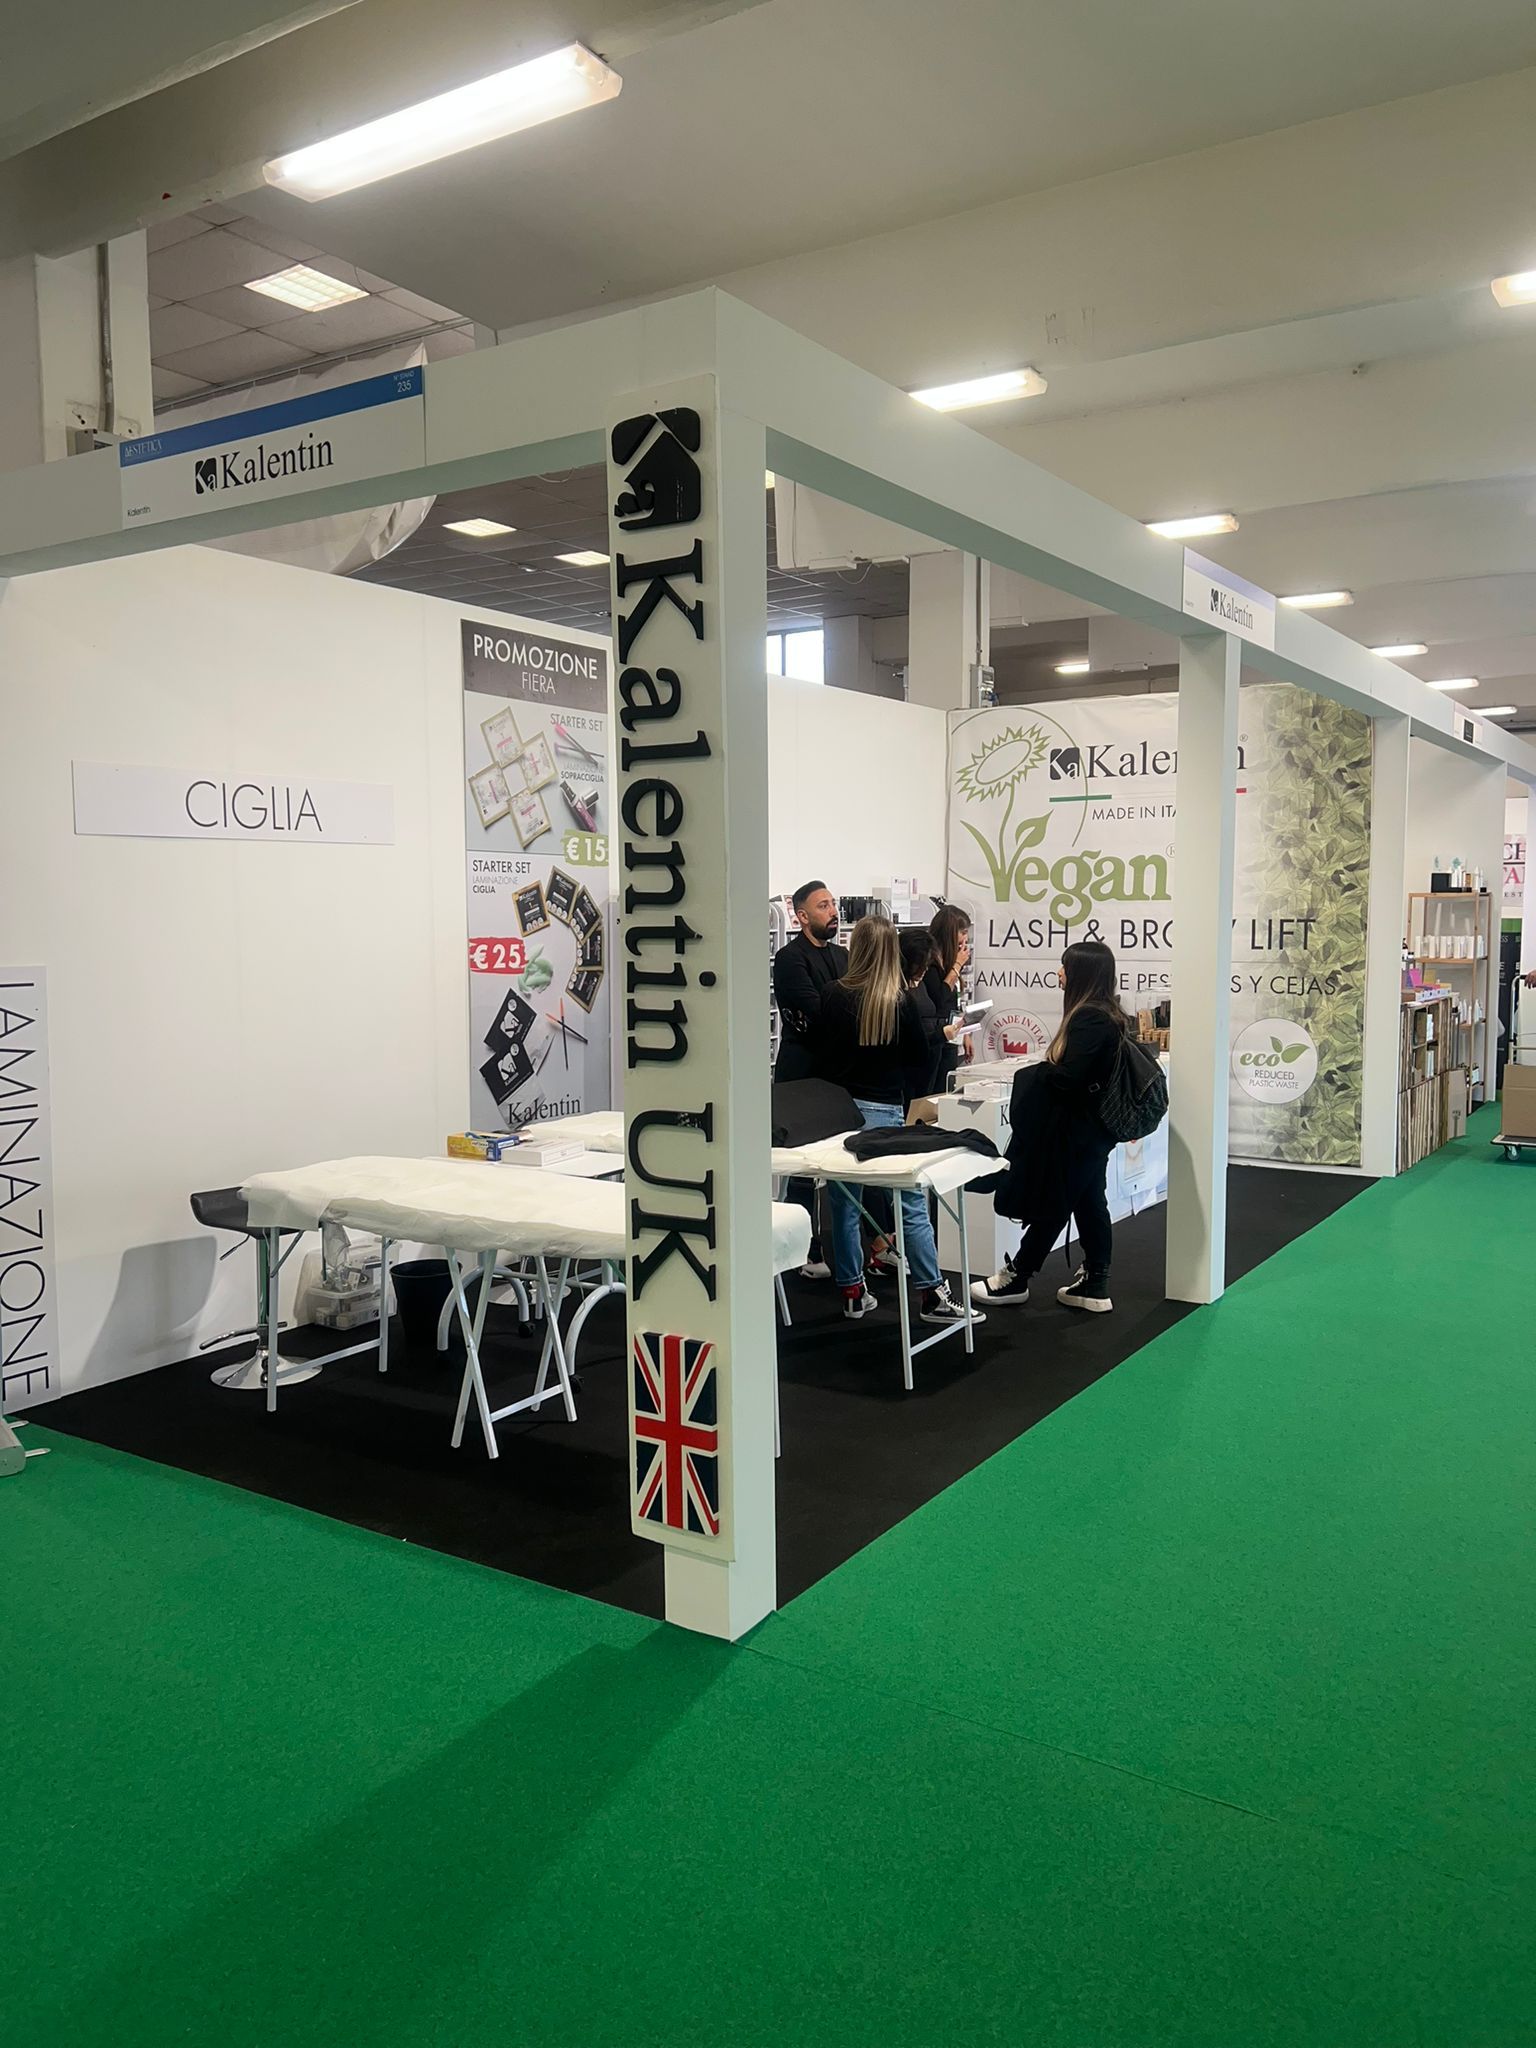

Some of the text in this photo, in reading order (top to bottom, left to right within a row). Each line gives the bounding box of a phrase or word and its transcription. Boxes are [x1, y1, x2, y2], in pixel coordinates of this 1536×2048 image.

[397, 380, 411, 392] 235
[220, 432, 334, 490] Kalentin
[1219, 592, 1253, 630] Kalentin
[473, 633, 598, 680] PROMOZIONE
[521, 671, 556, 694] FIERA
[550, 713, 604, 732] STARTER SET
[560, 770, 605, 783] SOPRACCIGLIA
[185, 781, 323, 832] CIGLIA
[616, 538, 717, 1069] Kalentin
[1092, 806, 1135, 820] MADE
[1140, 805, 1156, 819] IN
[566, 837, 606, 862] € 15
[472, 860, 531, 874] STARTER SET
[960, 810, 1172, 927] Vegan
[472, 876, 519, 885] LAMINAZIONE
[472, 885, 496, 894] CIGLIA
[988, 918, 1070, 949] LASH
[1083, 918, 1106, 944] &
[1251, 918, 1316, 950] LIFT
[473, 944, 521, 970] € 25
[1250, 975, 1263, 993] Y
[1270, 976, 1336, 996] CEJAS
[993, 1014, 1020, 1029] MADE
[1021, 1016, 1033, 1028] IN
[1239, 1052, 1280, 1067] eco
[1249, 1079, 1299, 1090] PLASTIC WASTE
[1254, 1069, 1295, 1081] REDUCED
[507, 1093, 581, 1125] Kalentin
[628, 1102, 717, 1301] UK
